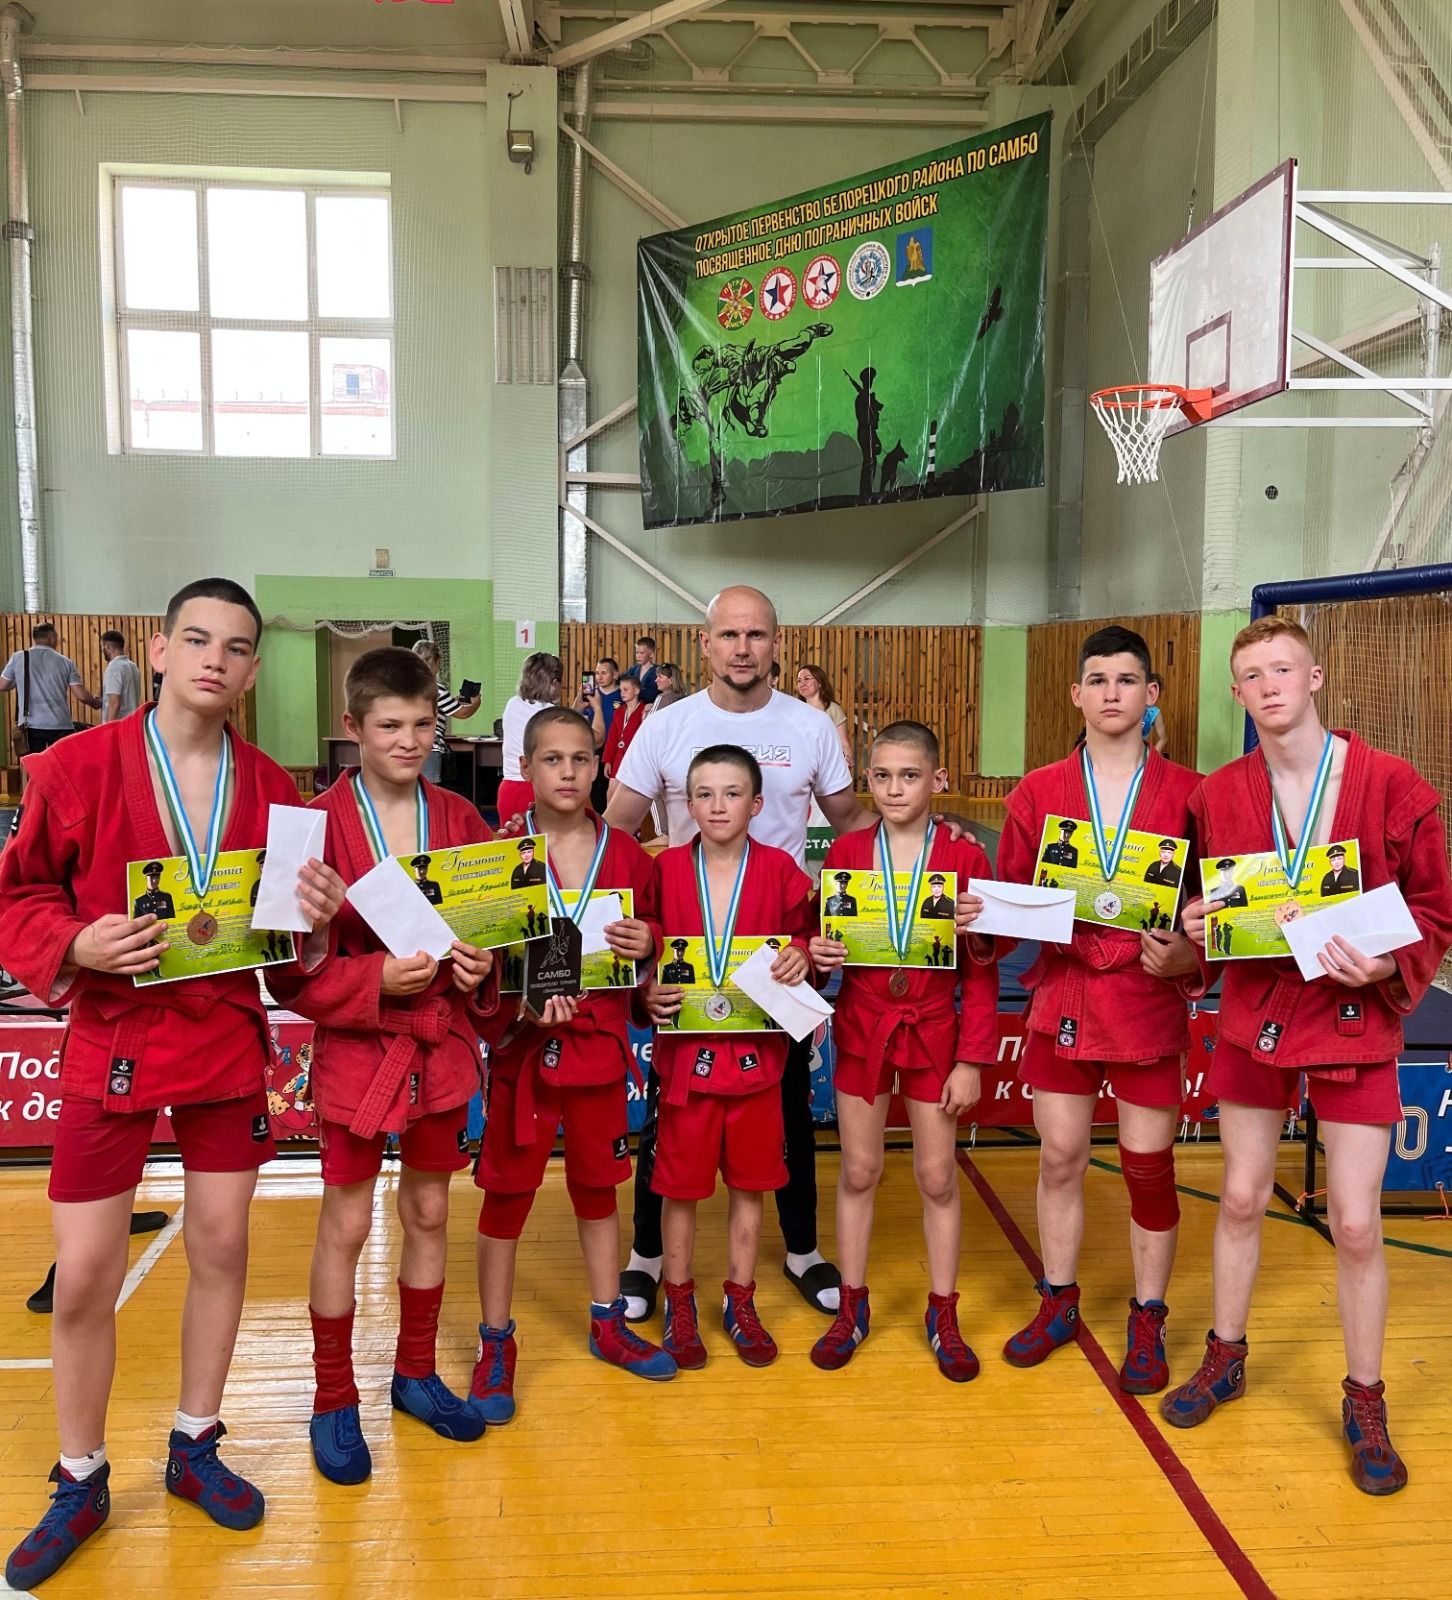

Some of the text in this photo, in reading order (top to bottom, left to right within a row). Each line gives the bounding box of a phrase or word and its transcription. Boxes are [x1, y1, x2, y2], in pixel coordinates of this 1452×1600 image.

[695, 131, 1039, 253] ОТКРЫТОЕ ПЕРВЕНСТВО БЕЛОРЕЦКОГО РАЙОНА ПО САМБО
[695, 192, 938, 279] ПОСВЯЩЕННОЕ ДНЮ ПОГРАНИЧНЫХ ВОЙСК
[520, 628, 529, 644] 1
[804, 838, 835, 850] СТА
[441, 850, 506, 872] Грамота
[537, 969, 571, 981] САМБО
[0, 1050, 60, 1080] Под
[22, 1091, 63, 1121] де
